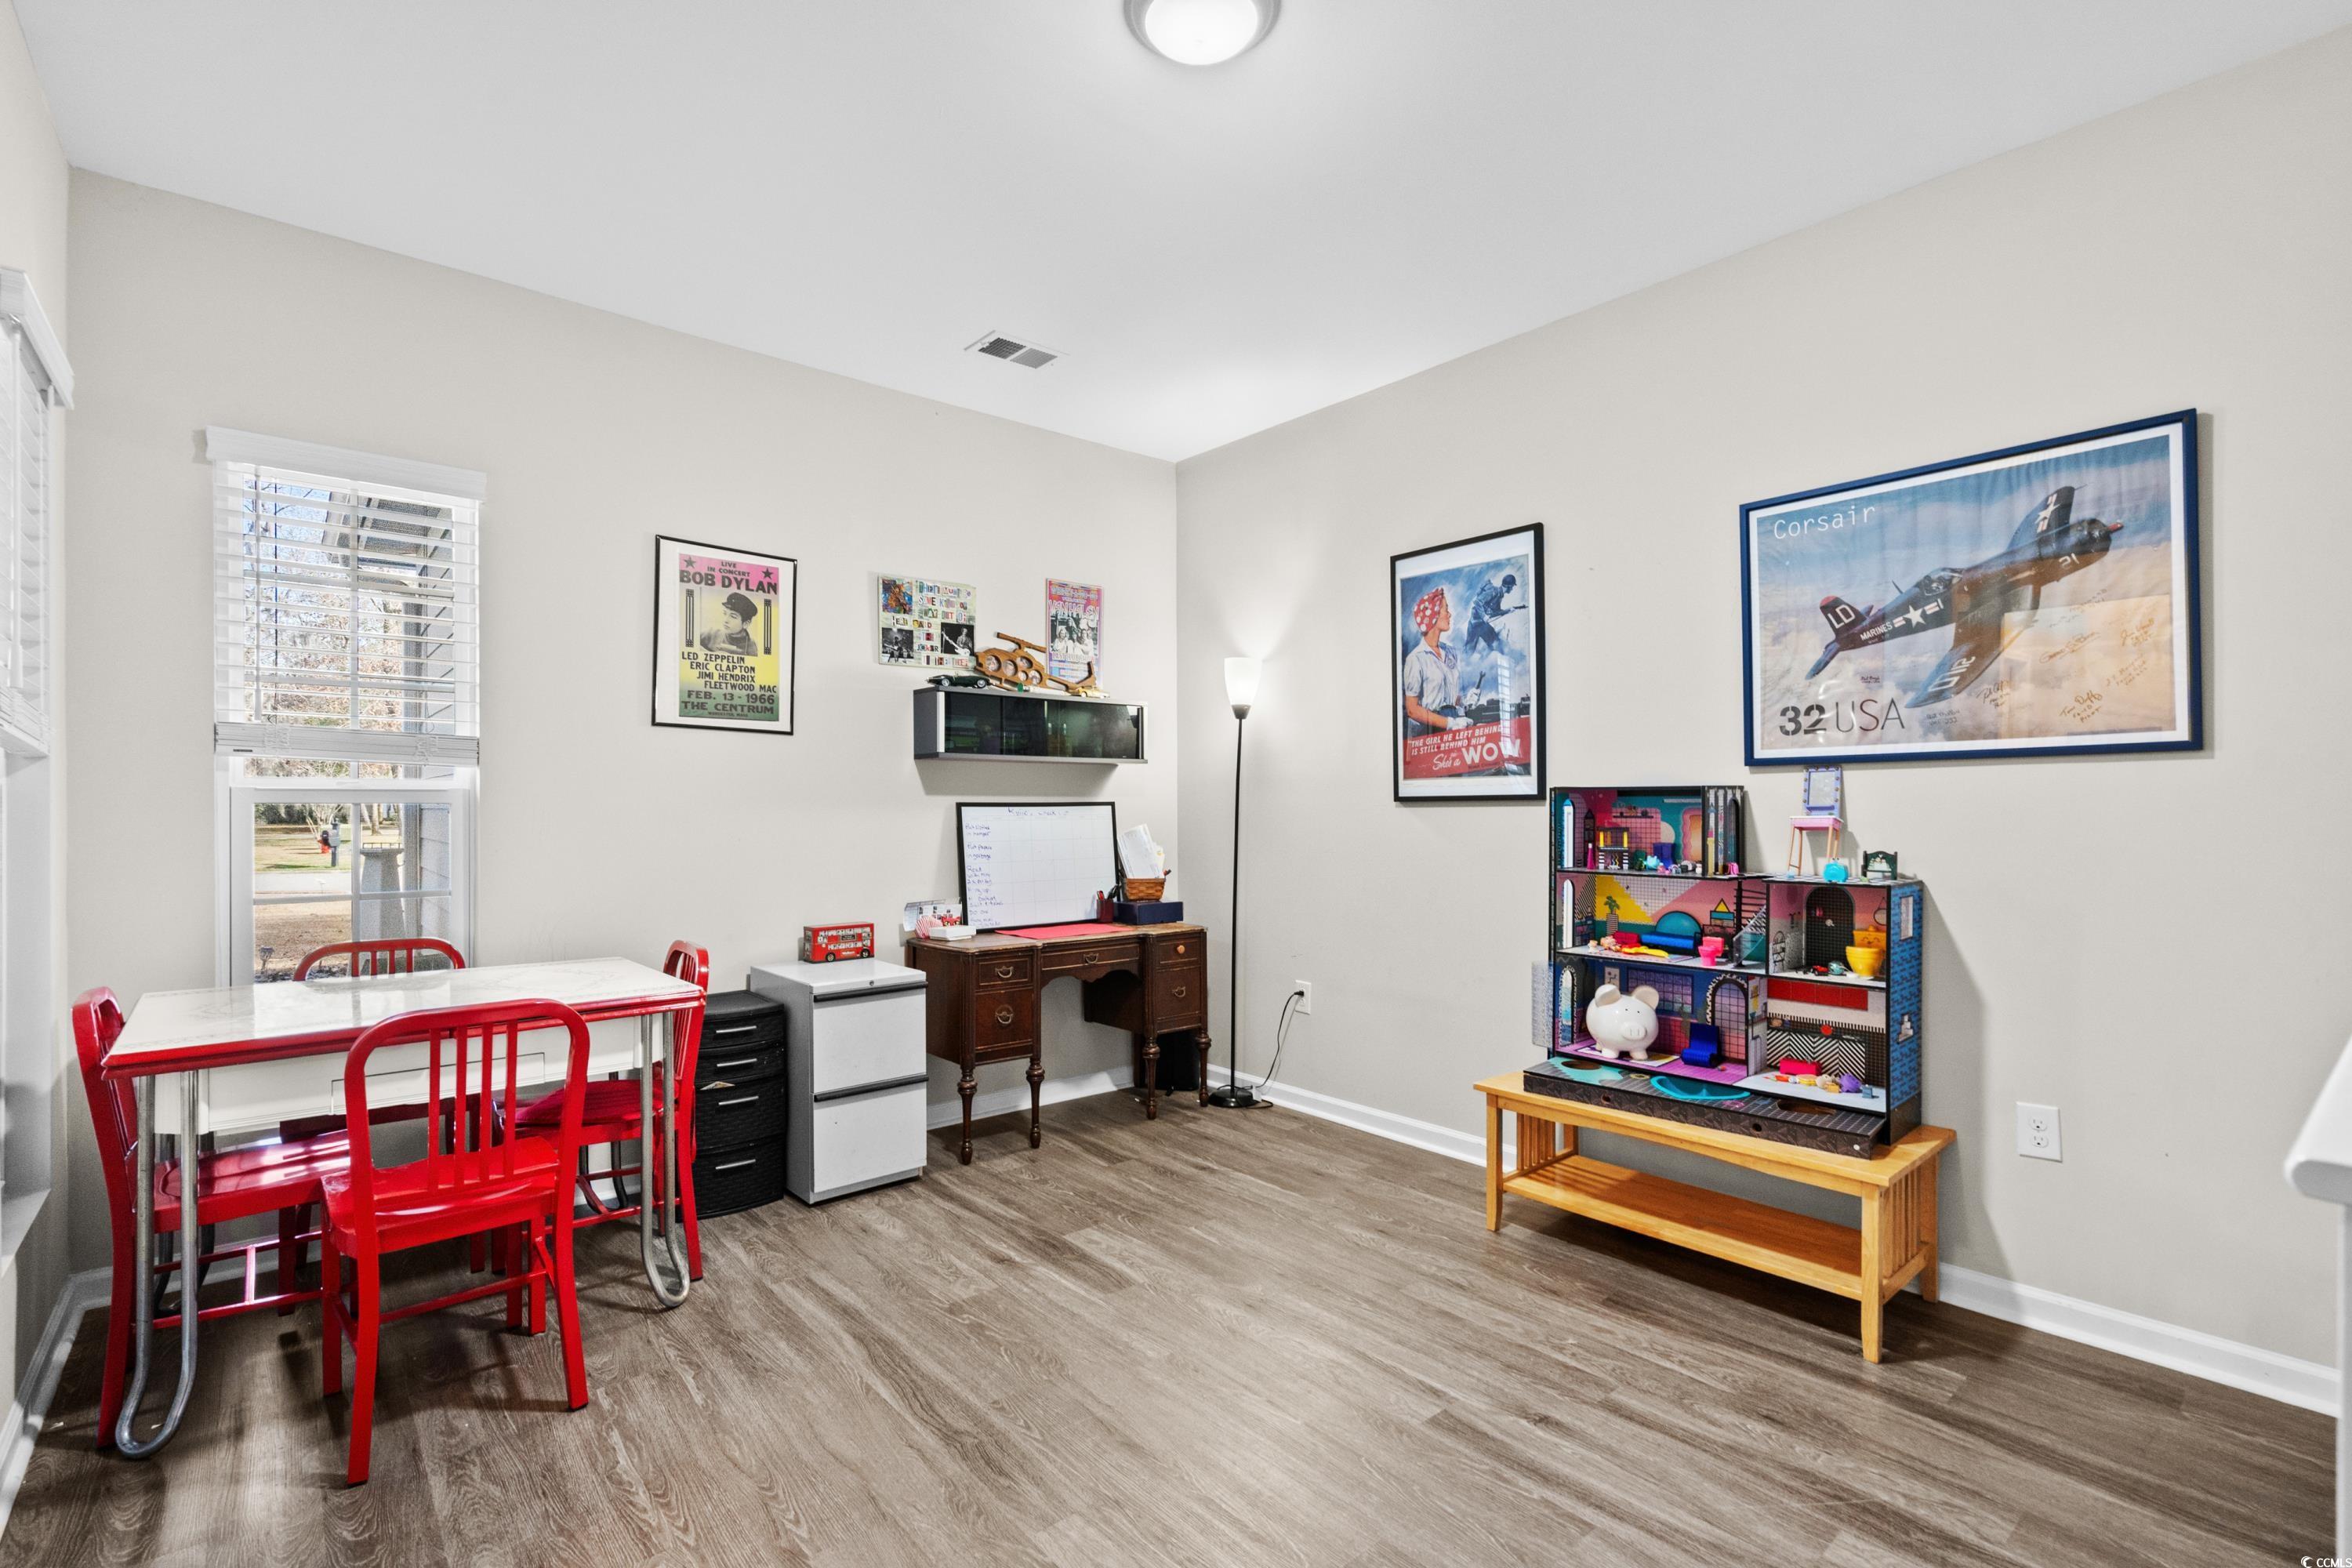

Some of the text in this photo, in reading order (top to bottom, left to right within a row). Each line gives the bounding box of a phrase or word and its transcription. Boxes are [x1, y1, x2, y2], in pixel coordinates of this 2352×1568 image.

[1773, 505, 1875, 539] Corsair
[2058, 552, 2080, 570] 21
[719, 568, 750, 577] CONCERT
[679, 569, 777, 595] BOB DYLAN
[1828, 604, 1857, 629] LD
[1860, 622, 1893, 641] MARINES
[681, 652, 745, 664] LED ZEPPELIN
[690, 661, 756, 673] ERIC CLAPTON
[696, 671, 756, 683] JIMI HENDRIX
[704, 680, 777, 693] FLEETWOOD MAC
[687, 690, 716, 700] FEB.
[722, 692, 735, 701] 13
[746, 693, 775, 705] 1966
[681, 701, 775, 714] THE CENTRUM
[1779, 703, 1828, 736] 32
[1835, 697, 1905, 732] USA
[1425, 735, 1440, 744] GIRL
[1455, 730, 1472, 739] LEFT
[1420, 746, 1438, 754] STILL
[1440, 740, 1468, 750] BEHIND
[1461, 739, 1521, 765] WOW
